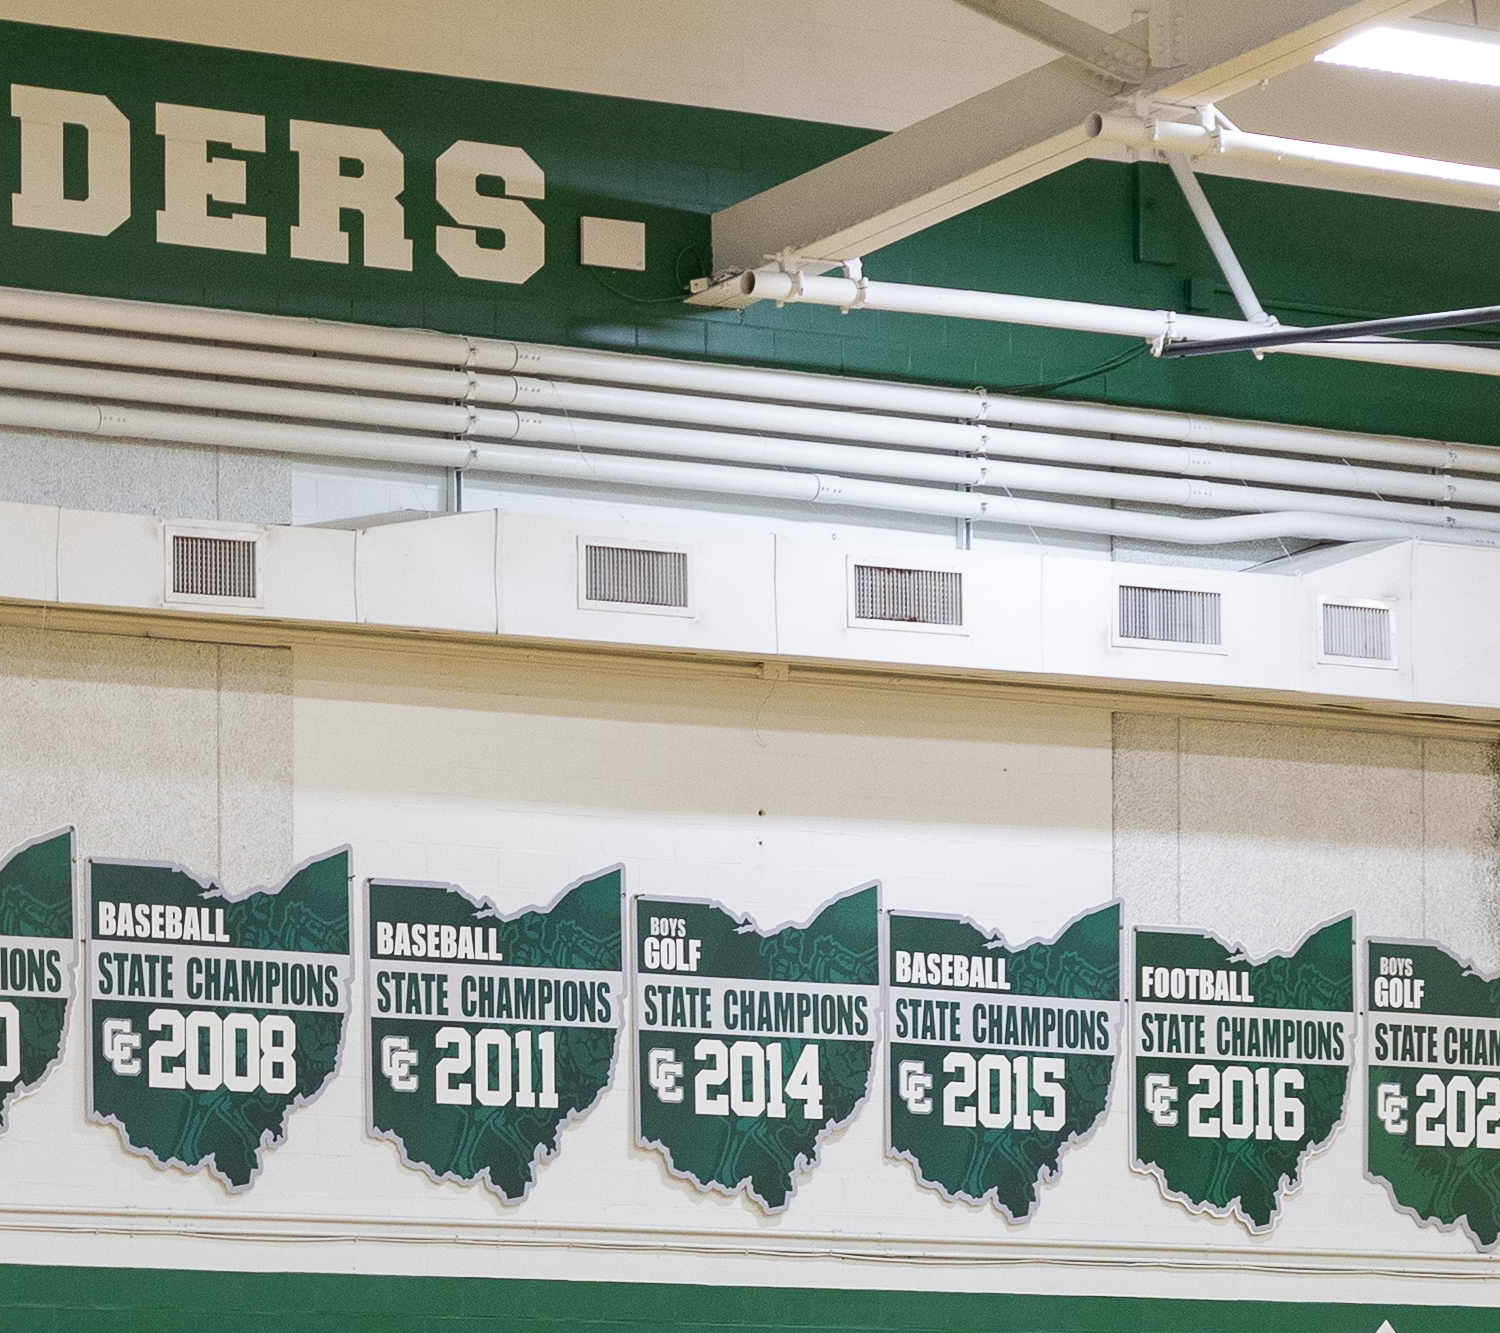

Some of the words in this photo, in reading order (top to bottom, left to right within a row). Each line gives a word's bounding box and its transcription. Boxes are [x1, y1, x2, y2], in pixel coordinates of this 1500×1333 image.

[99, 901, 229, 944] BASEBALL
[376, 921, 502, 961] BASEBALL
[650, 916, 686, 940] BOYS
[98, 952, 174, 999] STATE
[186, 957, 339, 1007] CHAMPIONS
[644, 938, 701, 973] GOLF
[896, 950, 1011, 991] BASEBALL
[1379, 957, 1413, 978] BOYS
[376, 971, 451, 1016] STATE
[461, 975, 612, 1023] CHAMPIONS
[1141, 966, 1254, 1003] FOOTBALL
[1374, 976, 1425, 1010] GOLF
[644, 984, 712, 1028] STATE
[723, 988, 868, 1037] CHAMPIONS
[896, 1002, 961, 1044] STATE
[972, 1005, 1109, 1052] CHAMPIONS
[148, 1009, 296, 1094] 2008
[1141, 1012, 1205, 1055] STATE
[1216, 1016, 1344, 1061] CHAMPIONS
[1375, 1024, 1437, 1064] STATE
[435, 1027, 558, 1109] 2011
[694, 1039, 823, 1120] 2014
[943, 1052, 1066, 1132] 2015
[1188, 1065, 1305, 1142] 2016
